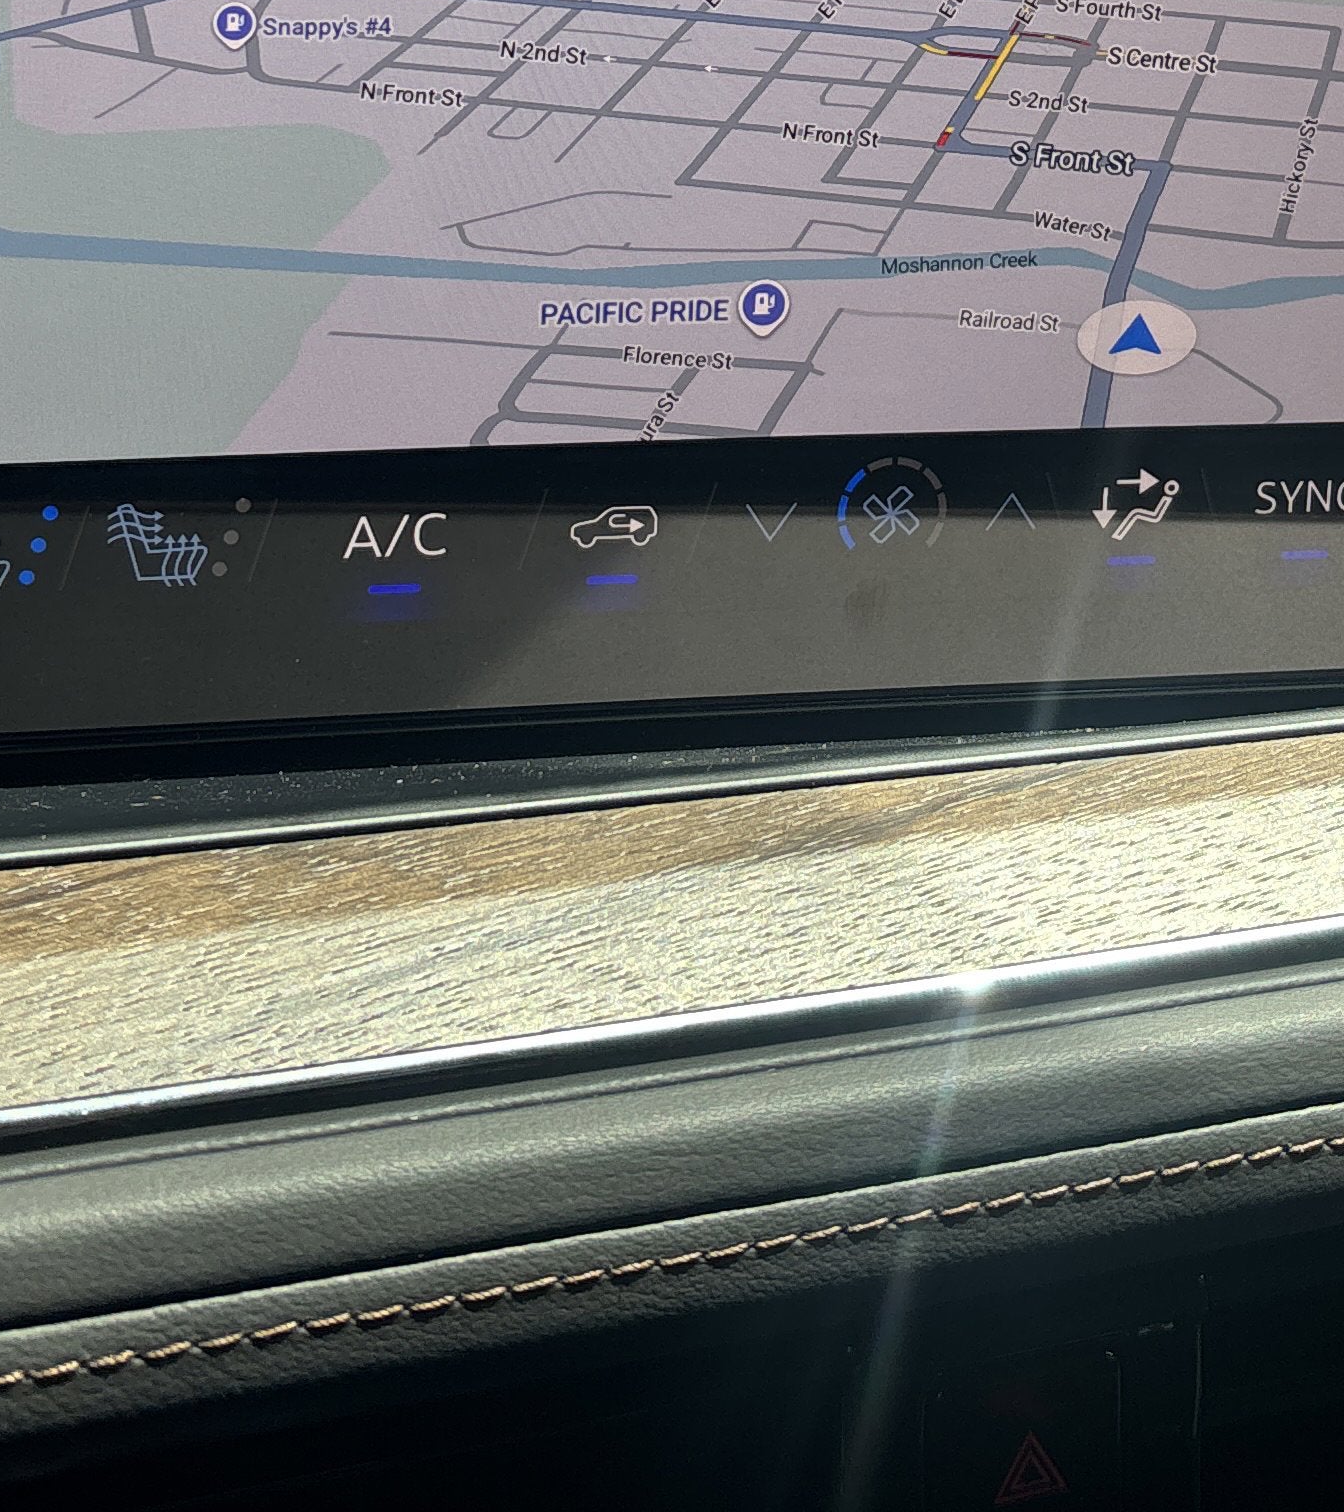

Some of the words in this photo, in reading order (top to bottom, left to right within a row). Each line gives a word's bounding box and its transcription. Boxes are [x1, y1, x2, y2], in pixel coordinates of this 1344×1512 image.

[939, 1, 957, 18] E
[1016, 7, 1034, 24] E
[1141, 3, 1162, 20] St
[263, 17, 357, 41] Snappy's
[365, 17, 392, 35] #4
[501, 41, 516, 58] N
[521, 43, 560, 63] 2nd
[565, 47, 587, 65] St
[1109, 48, 1122, 65] S
[1126, 50, 1190, 70] Centre
[1194, 54, 1217, 73] St
[361, 83, 375, 100] N
[382, 84, 436, 105] Front
[440, 89, 462, 107] St
[1009, 90, 1022, 107] S
[1026, 91, 1063, 111] 2nd
[1067, 95, 1088, 113] St
[783, 123, 798, 140] N
[803, 125, 853, 146] Front
[858, 130, 880, 148] St
[1010, 142, 1029, 165] S
[1035, 144, 1101, 172] Front
[1106, 149, 1134, 175] St
[1280, 142, 1315, 215] Hickory
[1300, 117, 1319, 139] St
[1034, 211, 1087, 235] Water
[1089, 222, 1112, 241] St
[881, 255, 985, 274] Moshannon
[990, 252, 1038, 268] Creek
[541, 301, 644, 325] PACIFIC
[651, 299, 730, 323] PRIDE
[959, 310, 1034, 331] Railroad
[1039, 315, 1059, 332] St
[623, 346, 706, 368] Florence
[711, 354, 732, 370] St
[342, 512, 447, 561] A/C
